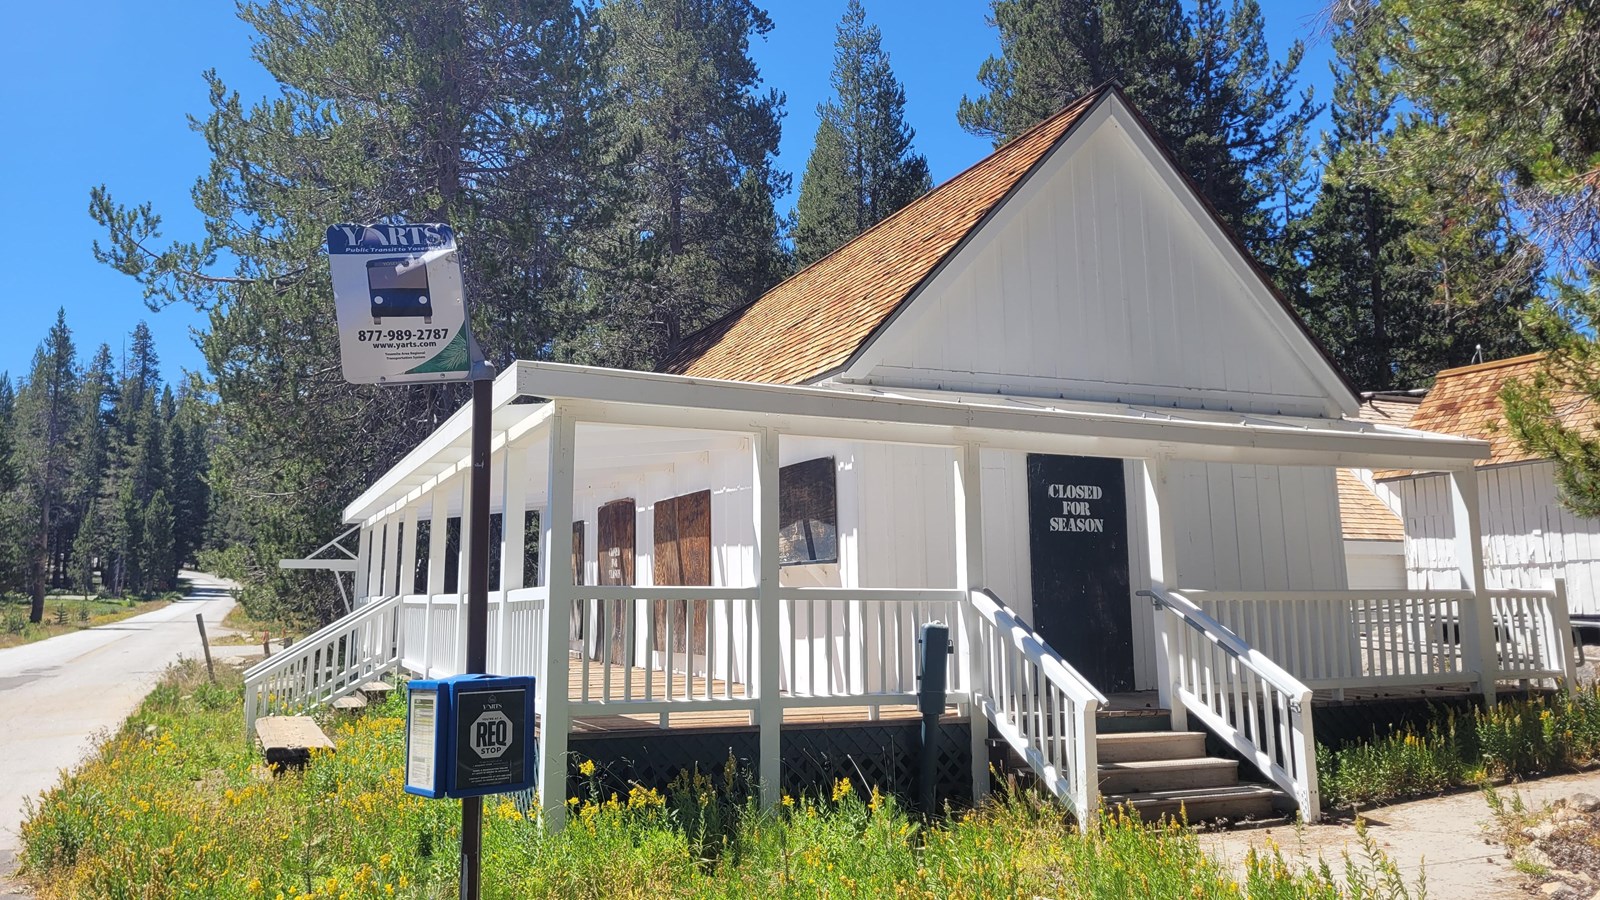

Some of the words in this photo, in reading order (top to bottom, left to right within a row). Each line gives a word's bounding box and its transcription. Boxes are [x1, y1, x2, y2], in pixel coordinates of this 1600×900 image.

[342, 226, 442, 246] YARTS
[358, 328, 448, 342] 877-989-2787
[372, 341, 436, 350] www.yarts.com
[1048, 484, 1102, 500] CLOSED
[1062, 501, 1090, 516] FOR
[1050, 517, 1104, 532] SEASON
[476, 720, 506, 747] REQ
